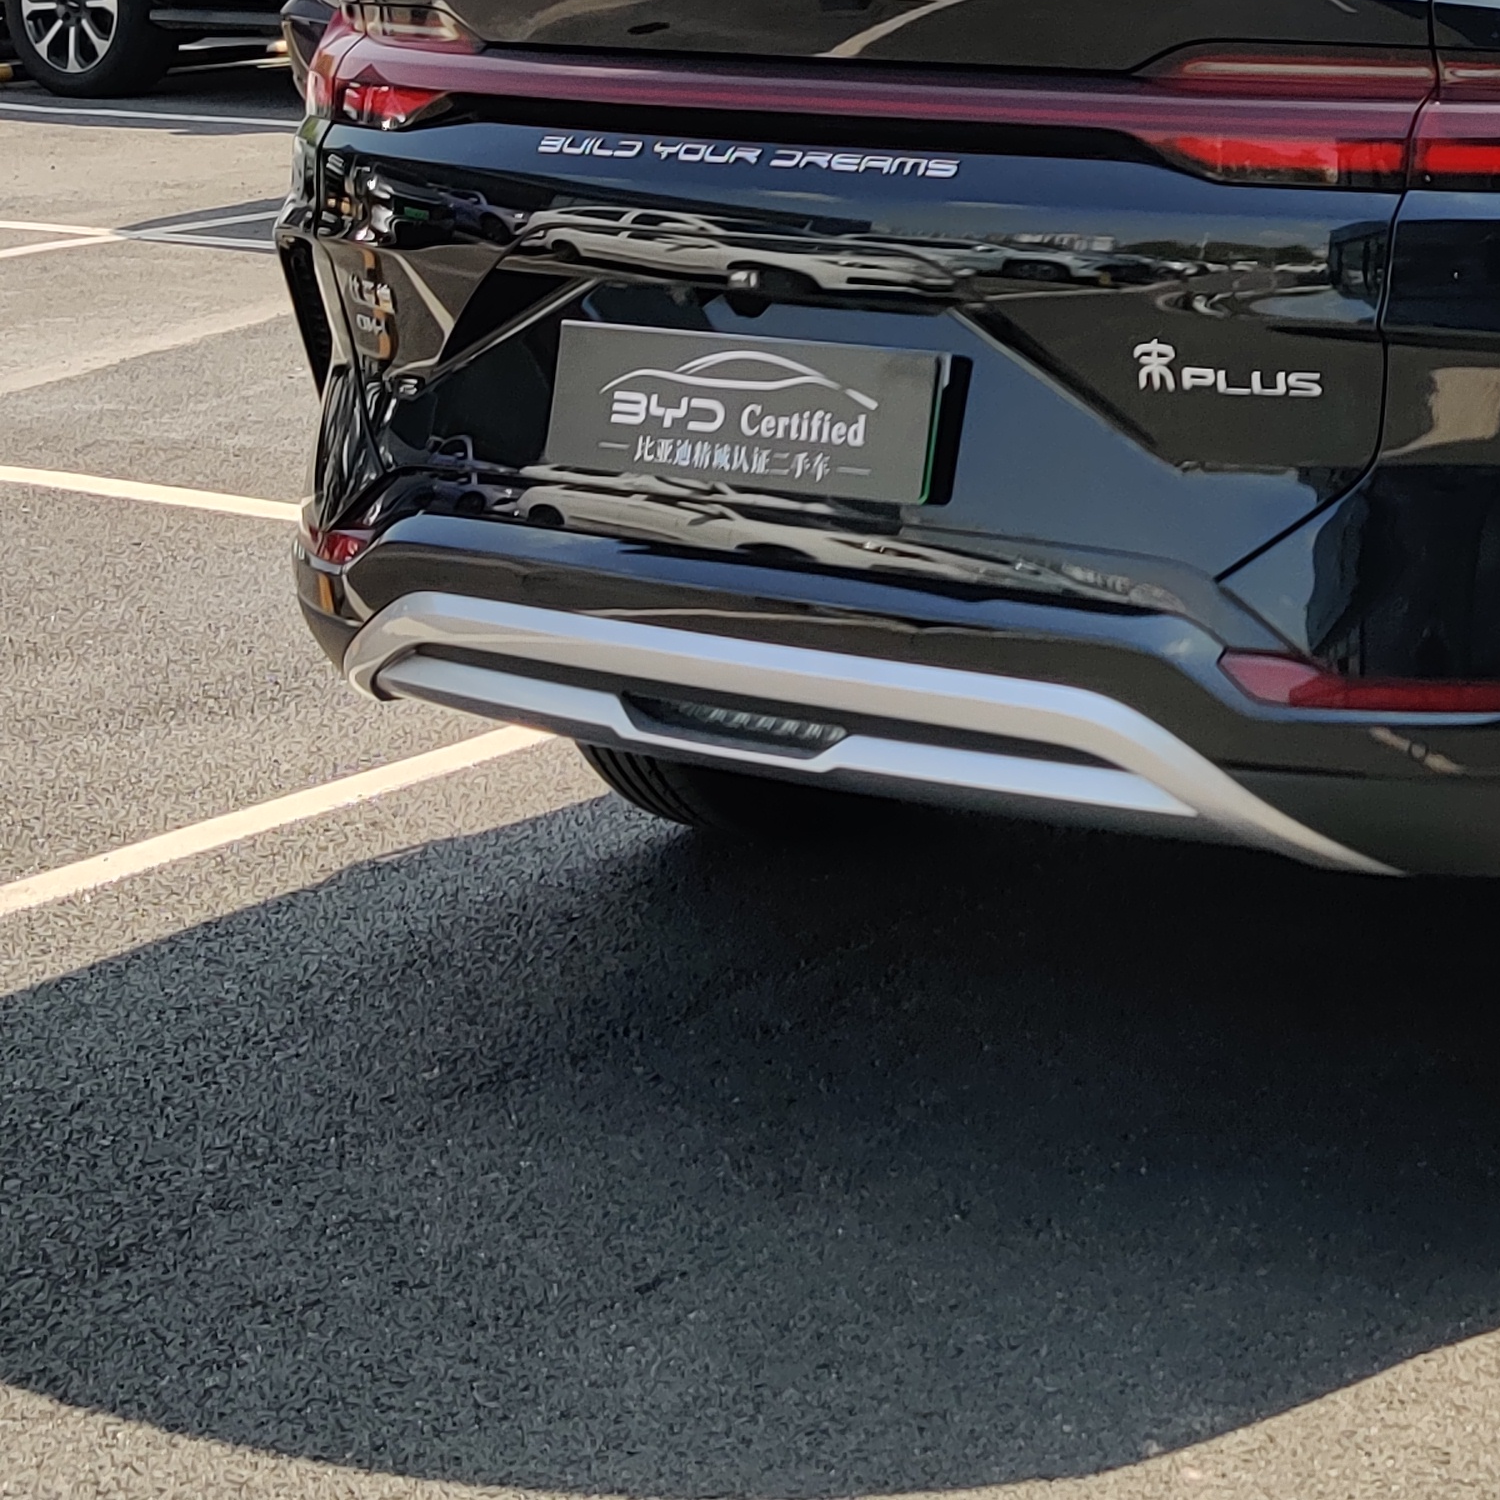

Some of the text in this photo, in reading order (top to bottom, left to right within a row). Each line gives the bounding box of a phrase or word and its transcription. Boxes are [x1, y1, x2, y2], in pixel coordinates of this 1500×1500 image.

[537, 135, 960, 179] BUILD YOUR DREAMS
[610, 390, 867, 447] BYD Certified
